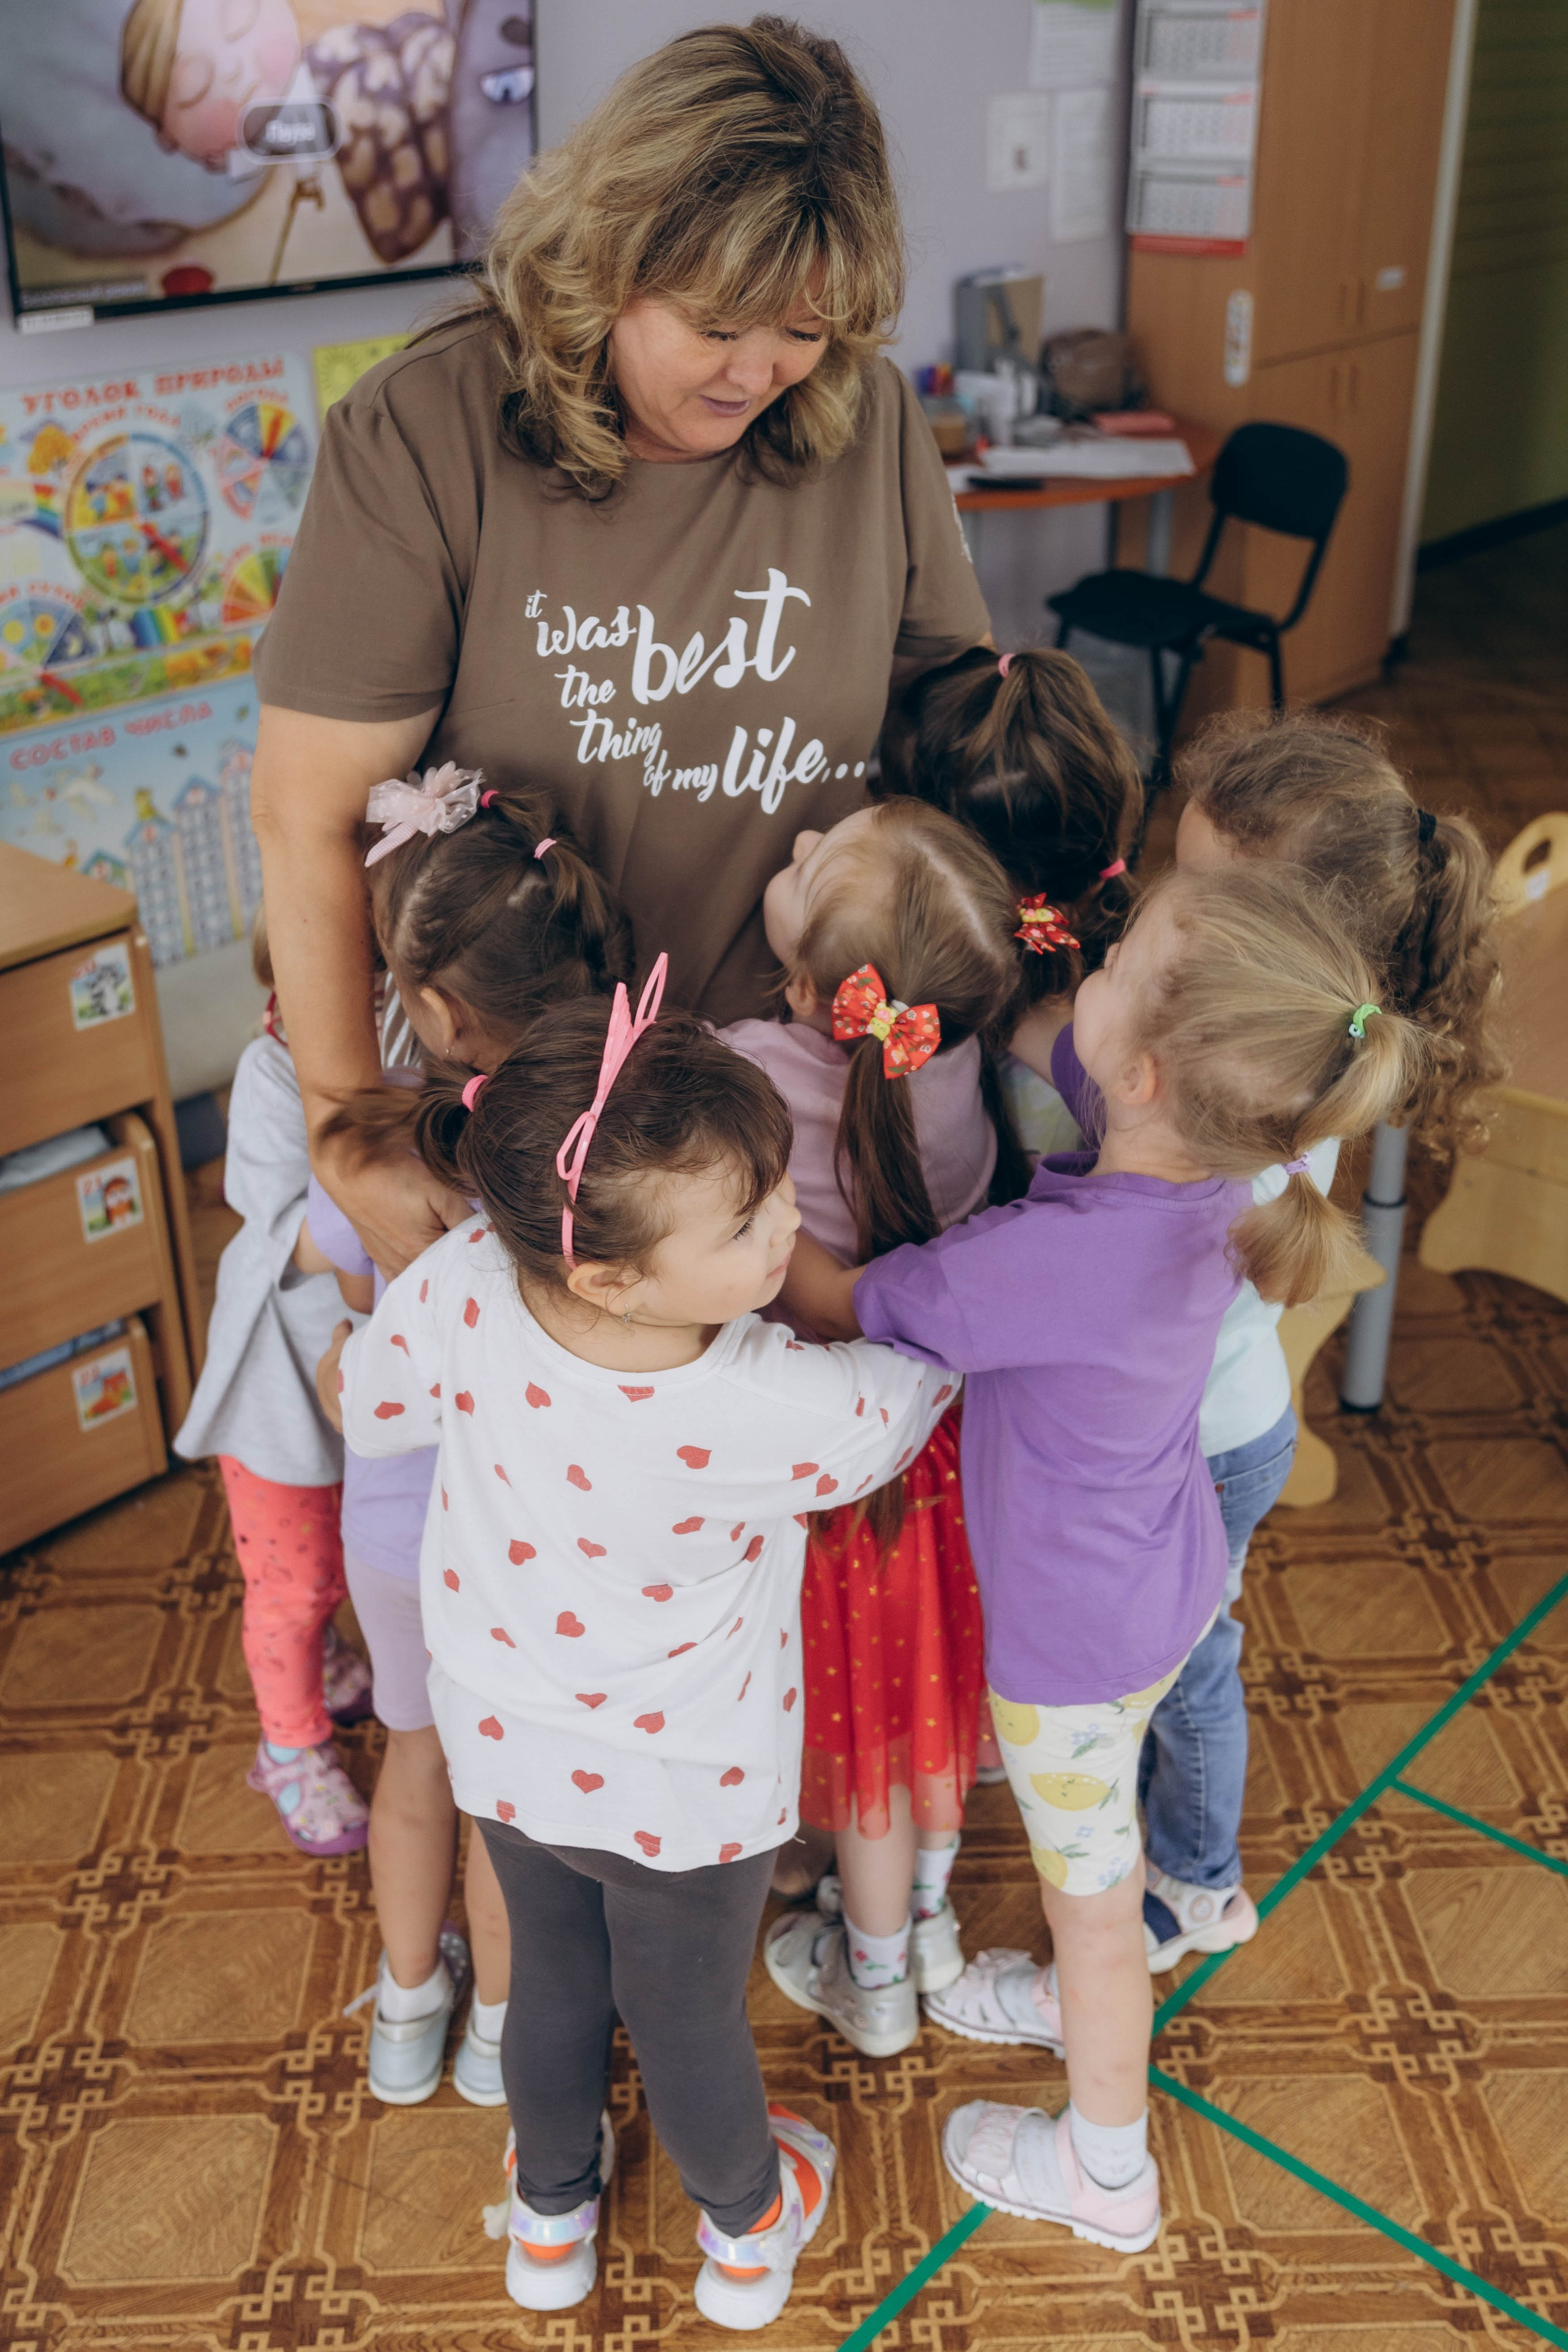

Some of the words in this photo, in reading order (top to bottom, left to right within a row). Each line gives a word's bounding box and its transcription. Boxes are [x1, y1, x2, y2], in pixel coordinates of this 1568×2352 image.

[21, 379, 140, 415] УГОЛОК
[154, 357, 284, 396] ПРИРОДЫ
[525, 589, 548, 619] it
[536, 605, 637, 657] was
[631, 567, 811, 705] best
[554, 664, 617, 708] the
[10, 725, 116, 771] СОСТАВ
[124, 701, 213, 736] ЧИСЛА
[569, 708, 663, 767] thing
[643, 749, 672, 797] of
[672, 763, 718, 802] my
